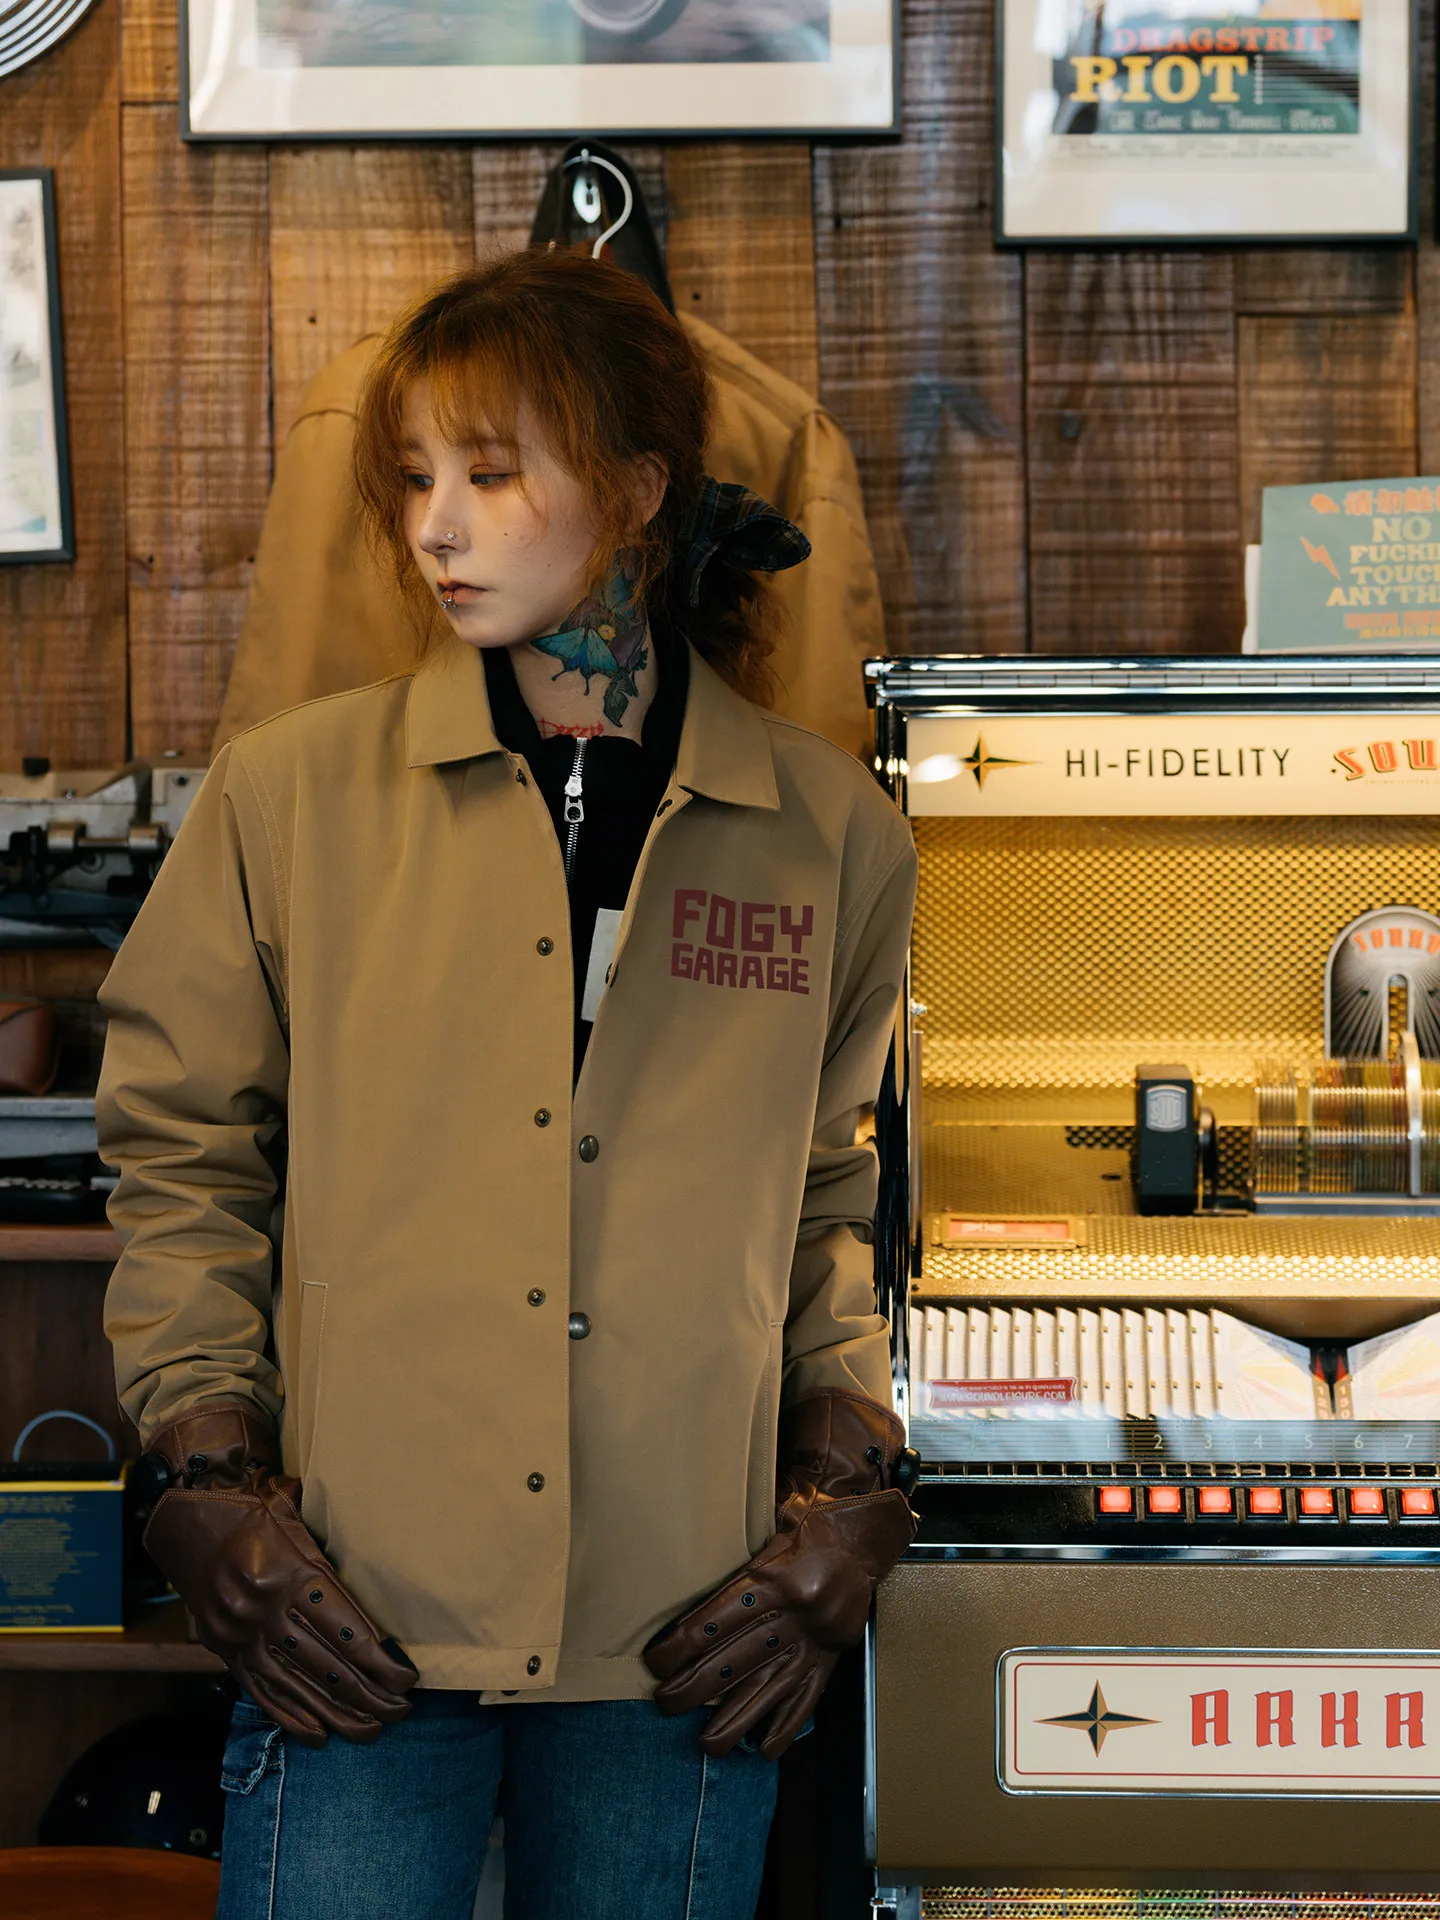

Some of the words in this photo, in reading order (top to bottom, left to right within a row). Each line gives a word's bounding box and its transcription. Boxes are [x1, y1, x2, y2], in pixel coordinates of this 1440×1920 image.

[1112, 26, 1336, 52] DRAGSTRIP
[1069, 56, 1249, 103] RIOT
[1372, 516, 1432, 543] NO
[1350, 542, 1440, 565] FUCKI
[1325, 584, 1440, 607] ANYTH
[1065, 748, 1291, 777] HI-FIDELITY
[673, 889, 814, 954] FOGY
[671, 943, 810, 995] GARAGE
[1153, 1434, 1164, 1449] 2
[1204, 1434, 1213, 1449] 3
[1254, 1434, 1264, 1449] 4
[1304, 1434, 1313, 1449] 5
[1354, 1434, 1364, 1449] 6
[1403, 1434, 1414, 1449] 7
